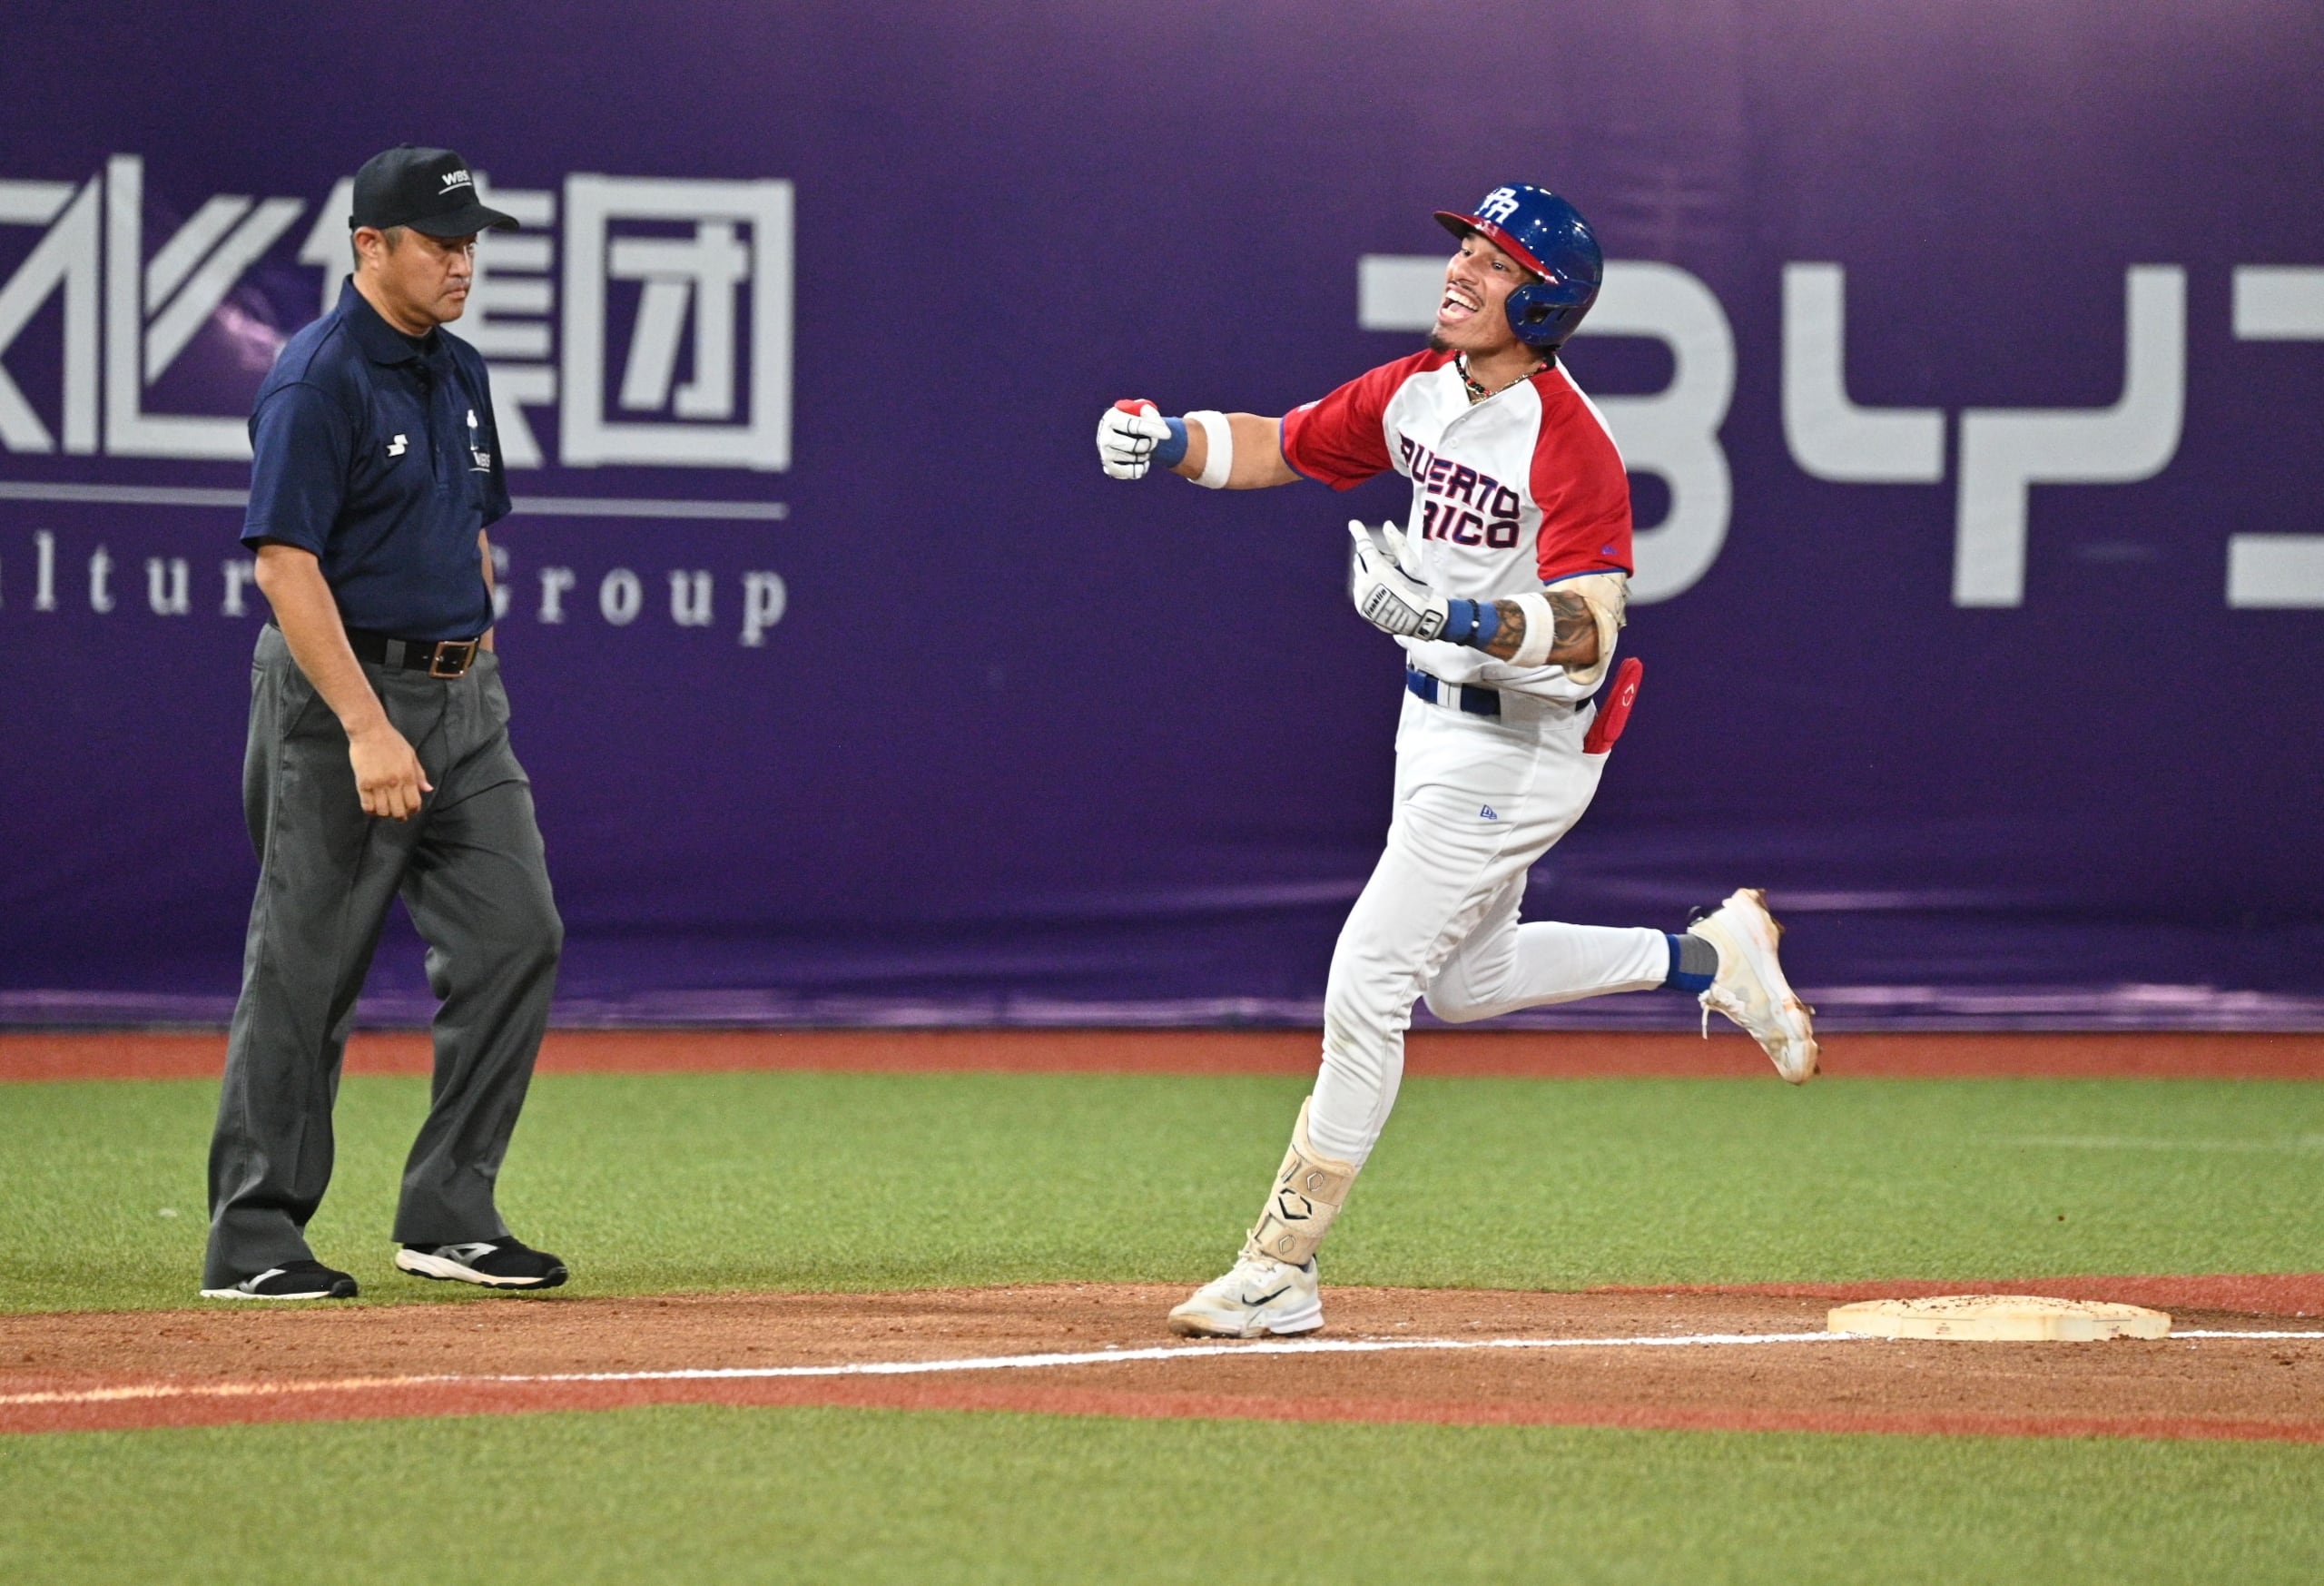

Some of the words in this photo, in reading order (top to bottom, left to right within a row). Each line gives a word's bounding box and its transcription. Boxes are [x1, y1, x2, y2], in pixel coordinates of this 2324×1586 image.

[441, 169, 471, 186] WBS
[1356, 253, 2324, 610] BY
[1399, 431, 1520, 519] PUERTO
[1422, 499, 1520, 549] RICO
[0, 529, 256, 616] ltur
